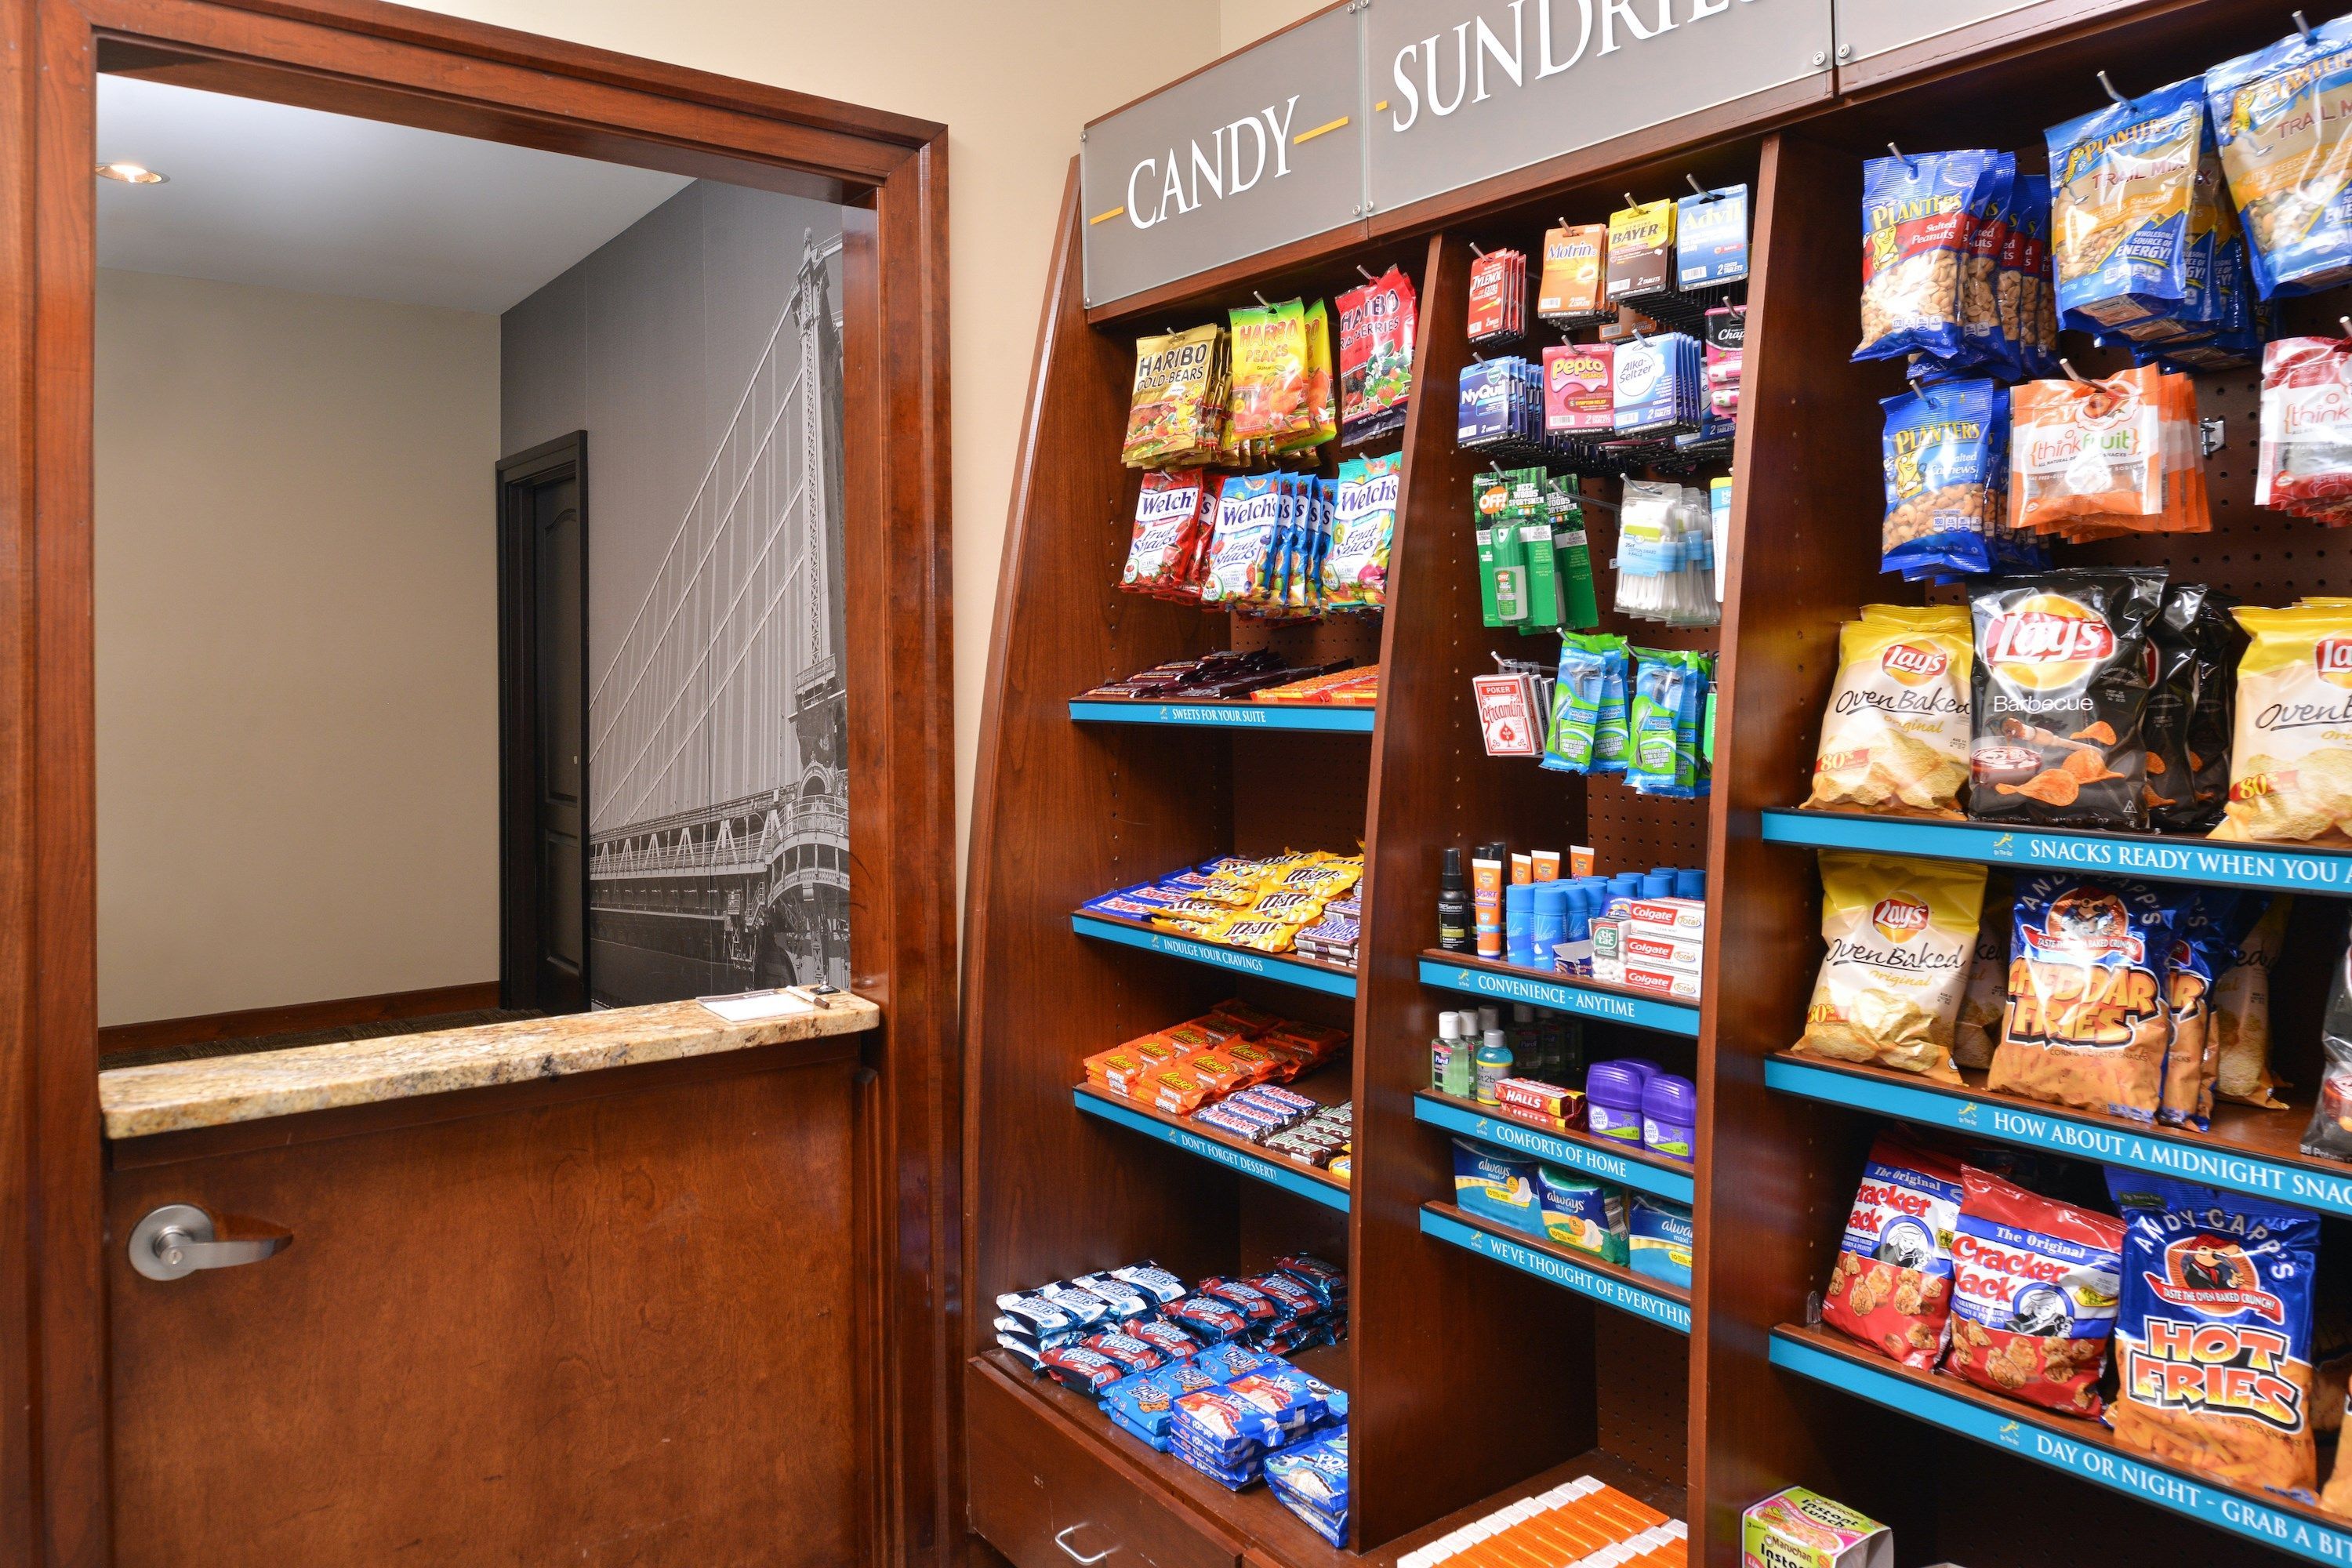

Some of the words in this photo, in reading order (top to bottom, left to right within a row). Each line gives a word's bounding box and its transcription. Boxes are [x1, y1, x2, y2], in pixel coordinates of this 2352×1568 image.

[1393, 0, 1760, 132] SUNDR
[1127, 95, 1300, 229] CANDY
[1683, 199, 1744, 230] Advil
[1872, 193, 1963, 229] PLANTERS
[1611, 223, 1659, 245] BAYER
[1911, 229, 1955, 245] Peanuts
[1926, 220, 1957, 232] Salted
[2136, 230, 2174, 240] WHOLESOME
[1547, 242, 1592, 261] Motrin
[2116, 243, 2172, 260] ENERGY!
[1470, 270, 1502, 294] TYLENOL
[1637, 277, 1644, 285] 2
[1341, 289, 1399, 332] HAIBO
[1138, 343, 1208, 377] HARIBO
[1552, 357, 1606, 380] Pepto
[1622, 358, 1647, 374] Alka-
[1619, 364, 1653, 384] Seltzer
[1461, 379, 1506, 406] NyQuil
[1895, 422, 1981, 455] PLANTERS
[1343, 479, 1398, 513] Welch's
[1479, 492, 1509, 511] OFF!
[1509, 496, 1545, 506] SPORTSMEN
[1513, 490, 1539, 499] WOODS
[1223, 497, 1277, 527] Welch's
[1346, 524, 1377, 545] Fruit
[1994, 614, 2108, 664] Lay's
[1884, 644, 1947, 674] Lay's
[1835, 689, 1894, 715] Oven
[1993, 695, 2094, 714] Barbecue
[1172, 708, 1200, 720] SWEETS
[1202, 710, 1216, 720] FOR
[1216, 710, 1242, 722] YOUR
[1242, 711, 1266, 723] SUITE
[2255, 702, 2342, 731] Oven
[1820, 751, 1855, 771] 80%
[2031, 840, 2111, 864] SNACKS
[2118, 844, 2191, 870] READY
[2198, 850, 2275, 877] WHEN
[2282, 856, 2338, 882] YOU
[1475, 887, 1497, 898] SPORT
[1632, 906, 1673, 922] Colgate
[1680, 916, 1700, 924] Total
[1875, 900, 1928, 929] Lay's
[1599, 936, 1613, 946] tac
[1601, 930, 1614, 939] tic
[1164, 939, 1198, 956] INDULGE
[1199, 947, 1222, 962] YOUR
[1222, 953, 1264, 972] CRAVINGS
[1629, 941, 1670, 956] Colgate
[1675, 952, 1694, 960] Total
[1826, 938, 1883, 966] Oven
[1885, 942, 1966, 969] Baked
[1628, 972, 1670, 986] Colgate
[1869, 969, 1932, 987] Original
[2009, 956, 2158, 1014] CHEDDAR
[1479, 975, 1566, 1004] CONVENIENCE
[1576, 993, 1635, 1018] ANYTIME
[2013, 997, 2131, 1042] FRIES
[1505, 1090, 1542, 1109] HALLS
[1181, 1134, 1207, 1153] DON'T
[1207, 1144, 1239, 1166] FORGET
[1240, 1157, 1278, 1181] DESSERT!
[1496, 1125, 1563, 1159] COMFORTS
[1566, 1149, 1582, 1166] OF
[1586, 1153, 1627, 1178] HOME
[1994, 1112, 2045, 1140] HOW
[2050, 1124, 2126, 1157] ABOUT
[2130, 1142, 2149, 1162] A
[2150, 1146, 2285, 1191] MIDNIGHT
[1478, 1158, 1511, 1179] always
[1874, 1166, 1892, 1178] The
[1893, 1170, 1941, 1192] Original
[1547, 1189, 1585, 1213] always
[1857, 1183, 1932, 1218] racker
[1848, 1207, 1883, 1234] ack
[1673, 1235, 1690, 1244] maxi
[1995, 1225, 2023, 1243] The
[2026, 1234, 2086, 1261] Original
[2136, 1209, 2195, 1254] ANDY
[2207, 1207, 2296, 1280] CAPP'S
[1490, 1239, 1526, 1265] WE'VE
[1527, 1252, 1593, 1290] THOUGHT
[1595, 1279, 1613, 1298] OF
[1952, 1235, 2069, 1285] Cracker
[2163, 1287, 2183, 1301] TASTE
[2183, 1290, 2195, 1301] THE
[2196, 1290, 2216, 1302] OVEN
[2216, 1292, 2241, 1305] BAKED
[2241, 1294, 2277, 1311] CRUNCH!
[1066, 1351, 1104, 1368] TREATS
[1104, 1338, 1143, 1355] TREATS
[2149, 1322, 2285, 1372] HOT
[2131, 1356, 2299, 1428] FRIES
[2038, 1435, 2080, 1465] DAY
[2082, 1450, 2117, 1479] OR
[2122, 1463, 2201, 1508] NIGHT
[2222, 1497, 2288, 1541] GRAB
[2294, 1527, 2314, 1550] A
[1801, 1498, 1860, 1527] Instant
[1801, 1506, 1846, 1529] Lunch
[1772, 1535, 1813, 1564] Maruchan
